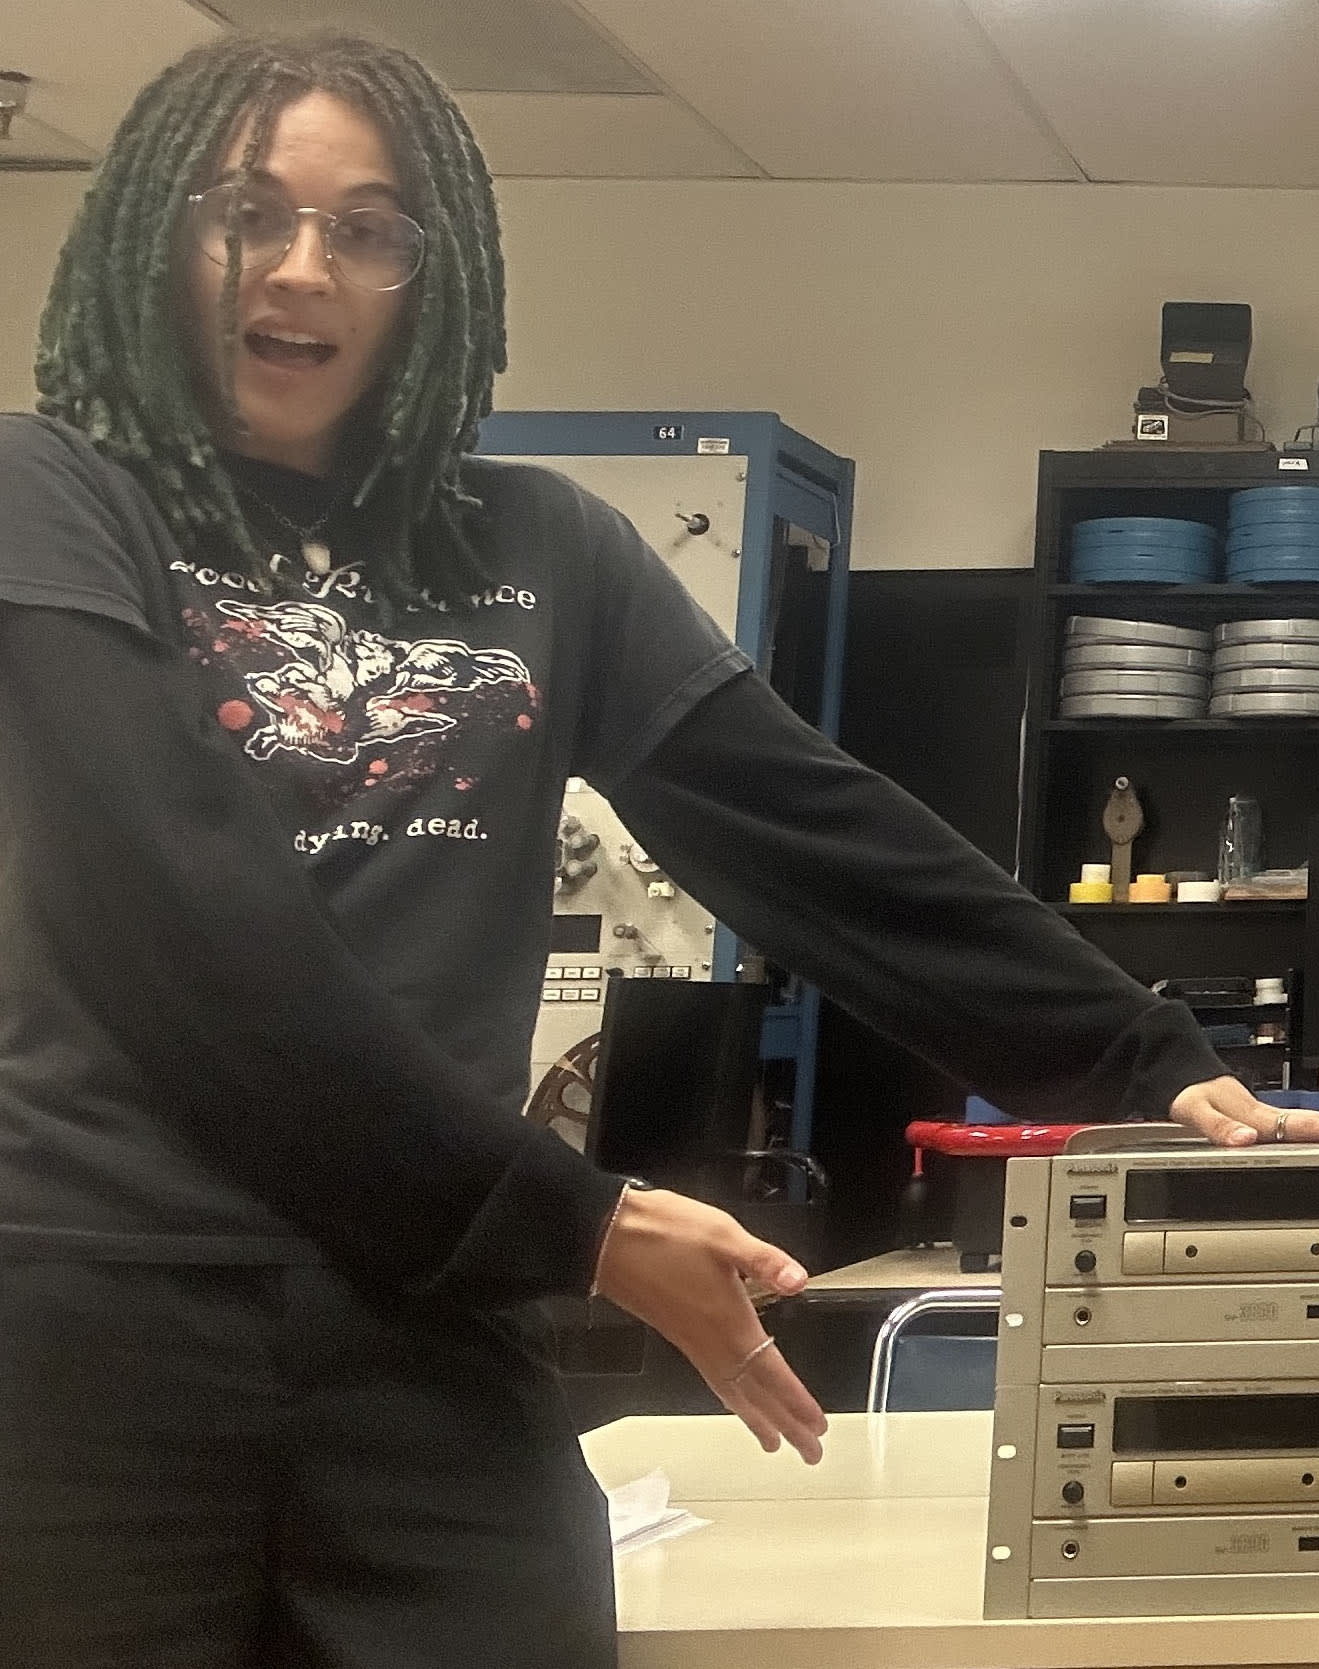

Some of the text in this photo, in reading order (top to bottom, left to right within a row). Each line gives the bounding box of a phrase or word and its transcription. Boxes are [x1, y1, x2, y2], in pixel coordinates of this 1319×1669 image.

[658, 426, 676, 440] 64
[293, 816, 489, 855] dying. dead.
